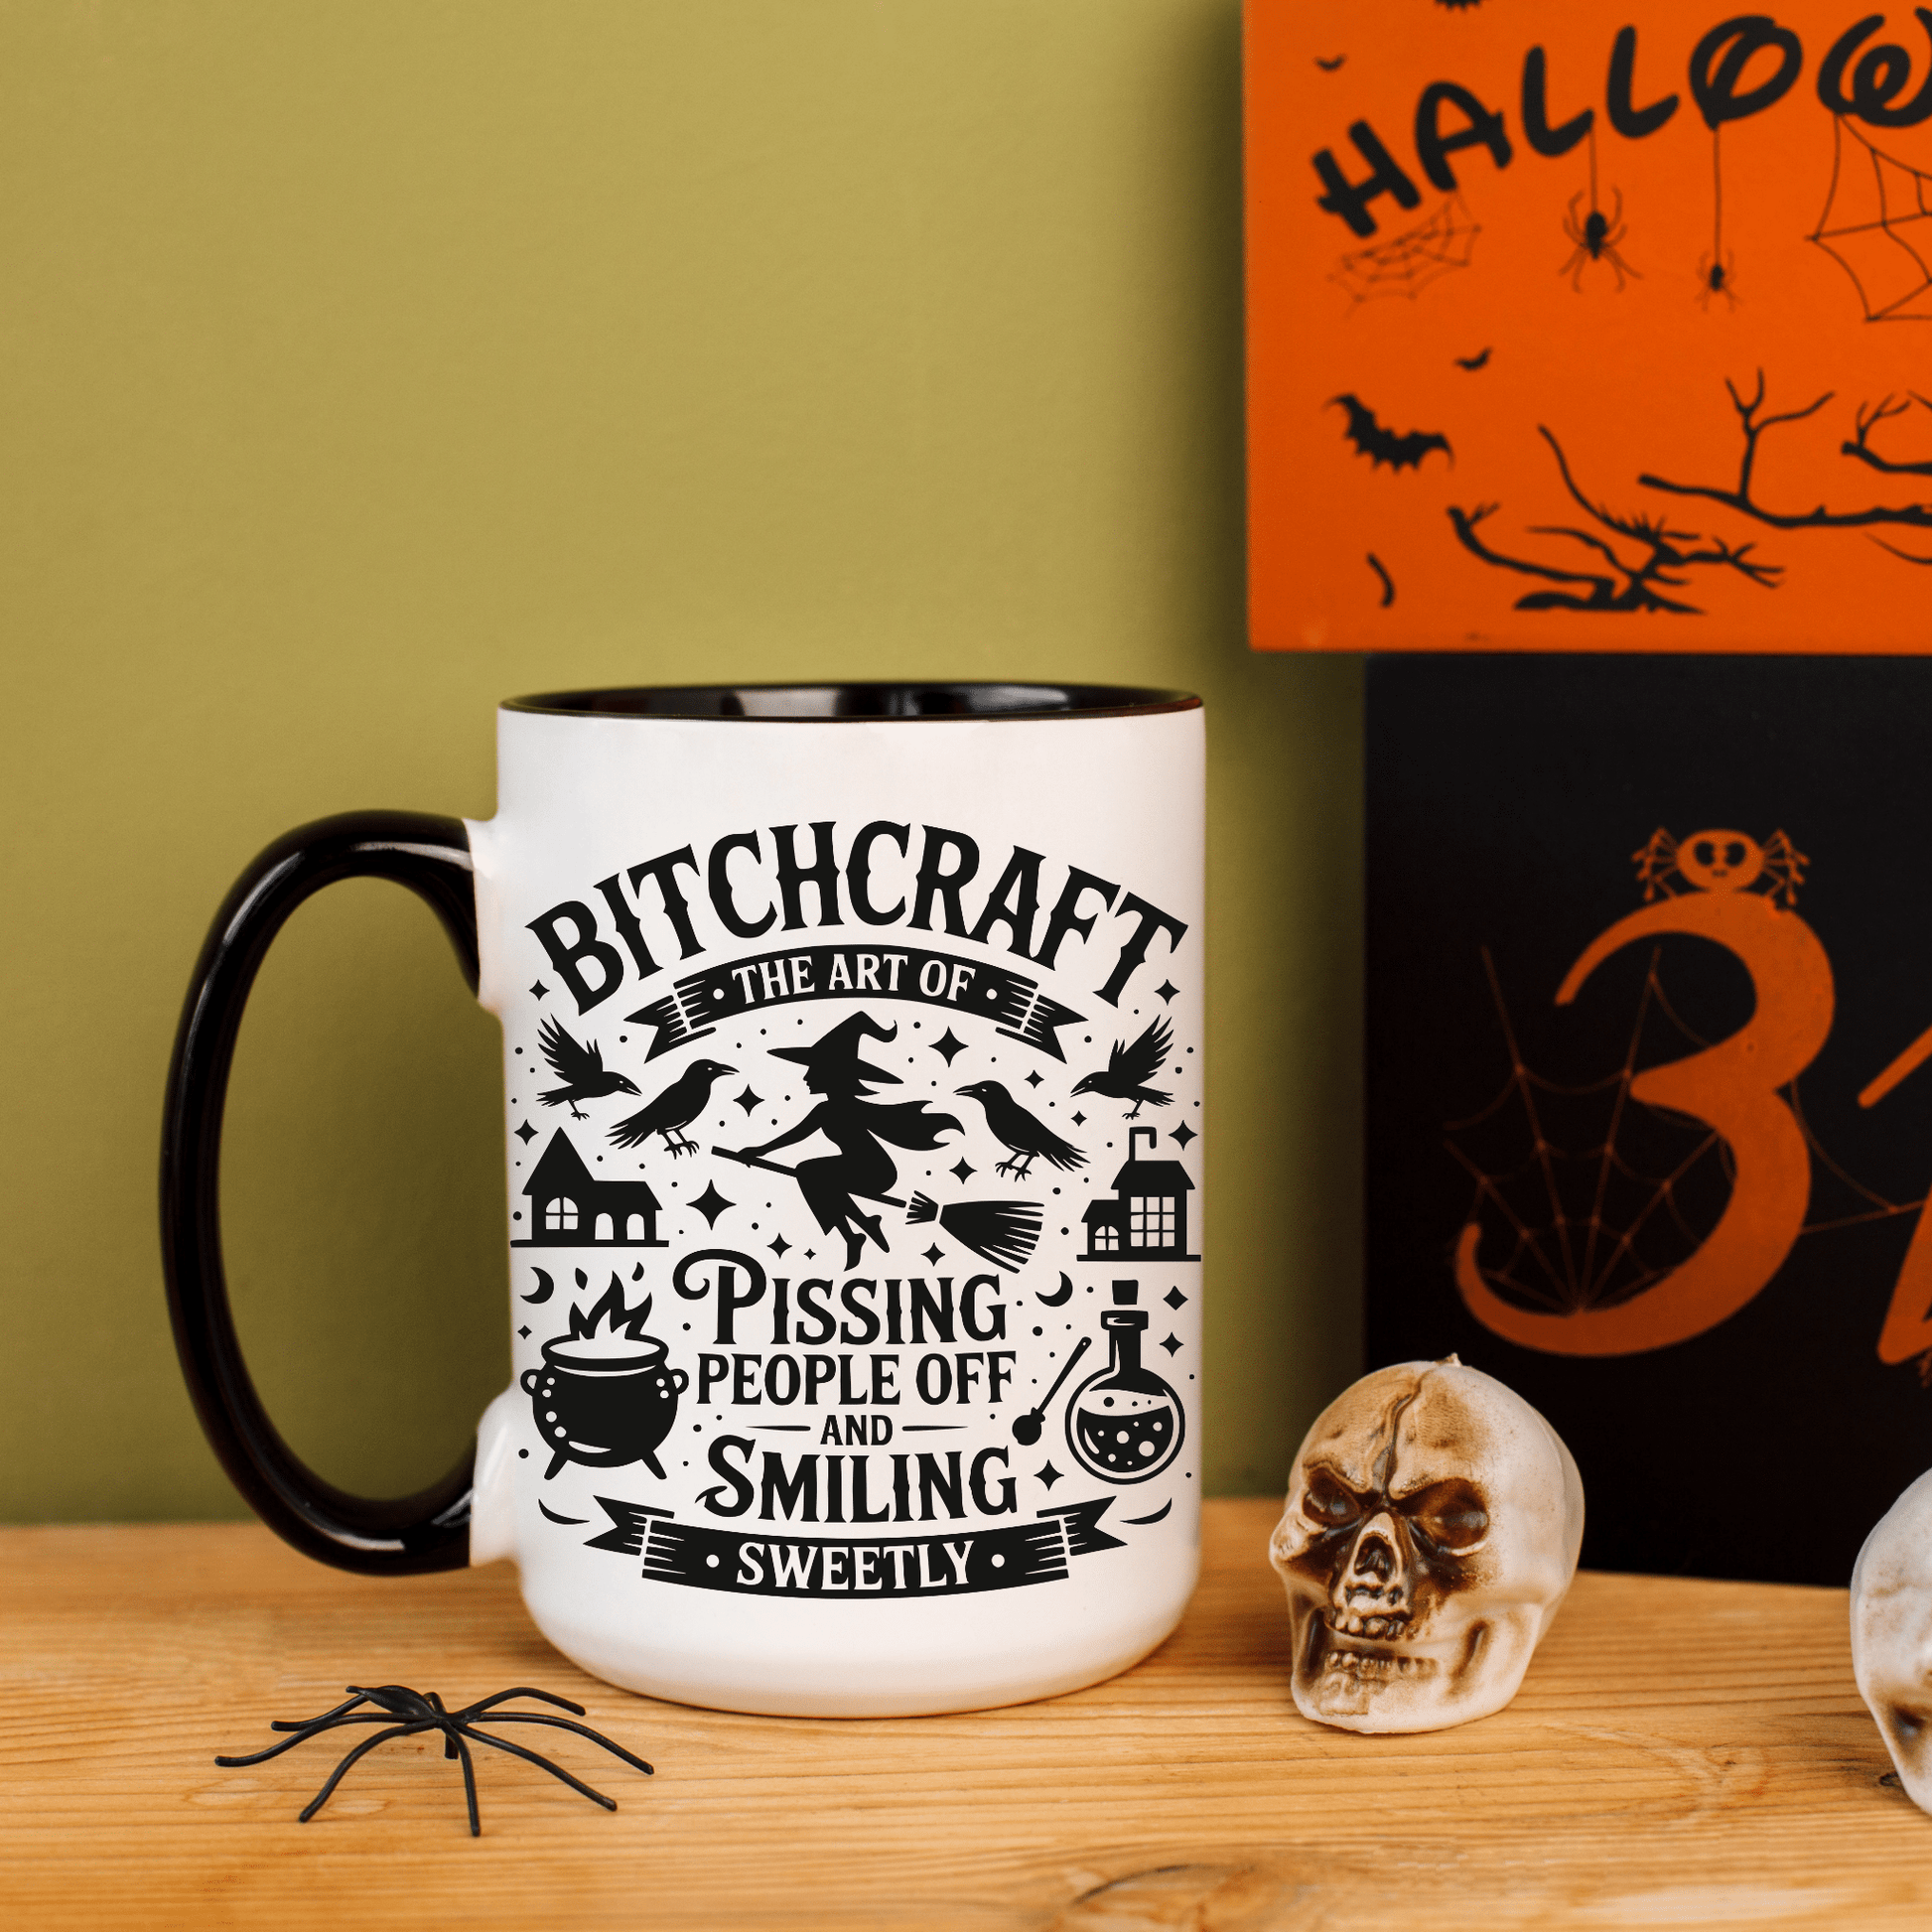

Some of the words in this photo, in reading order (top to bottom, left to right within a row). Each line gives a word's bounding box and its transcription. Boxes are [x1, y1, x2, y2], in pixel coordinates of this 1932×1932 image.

[523, 819, 1189, 1017] BITCHCRAFT
[731, 955, 815, 1005] THE
[828, 953, 909, 992] ART
[918, 958, 978, 1003] OF
[672, 1248, 1007, 1346] PISSING
[696, 1352, 900, 1406] PEOPLE
[915, 1350, 1017, 1406] OFF
[820, 1414, 894, 1447] AND
[694, 1434, 1018, 1523] SMILING
[736, 1540, 975, 1590] SWEETLY
